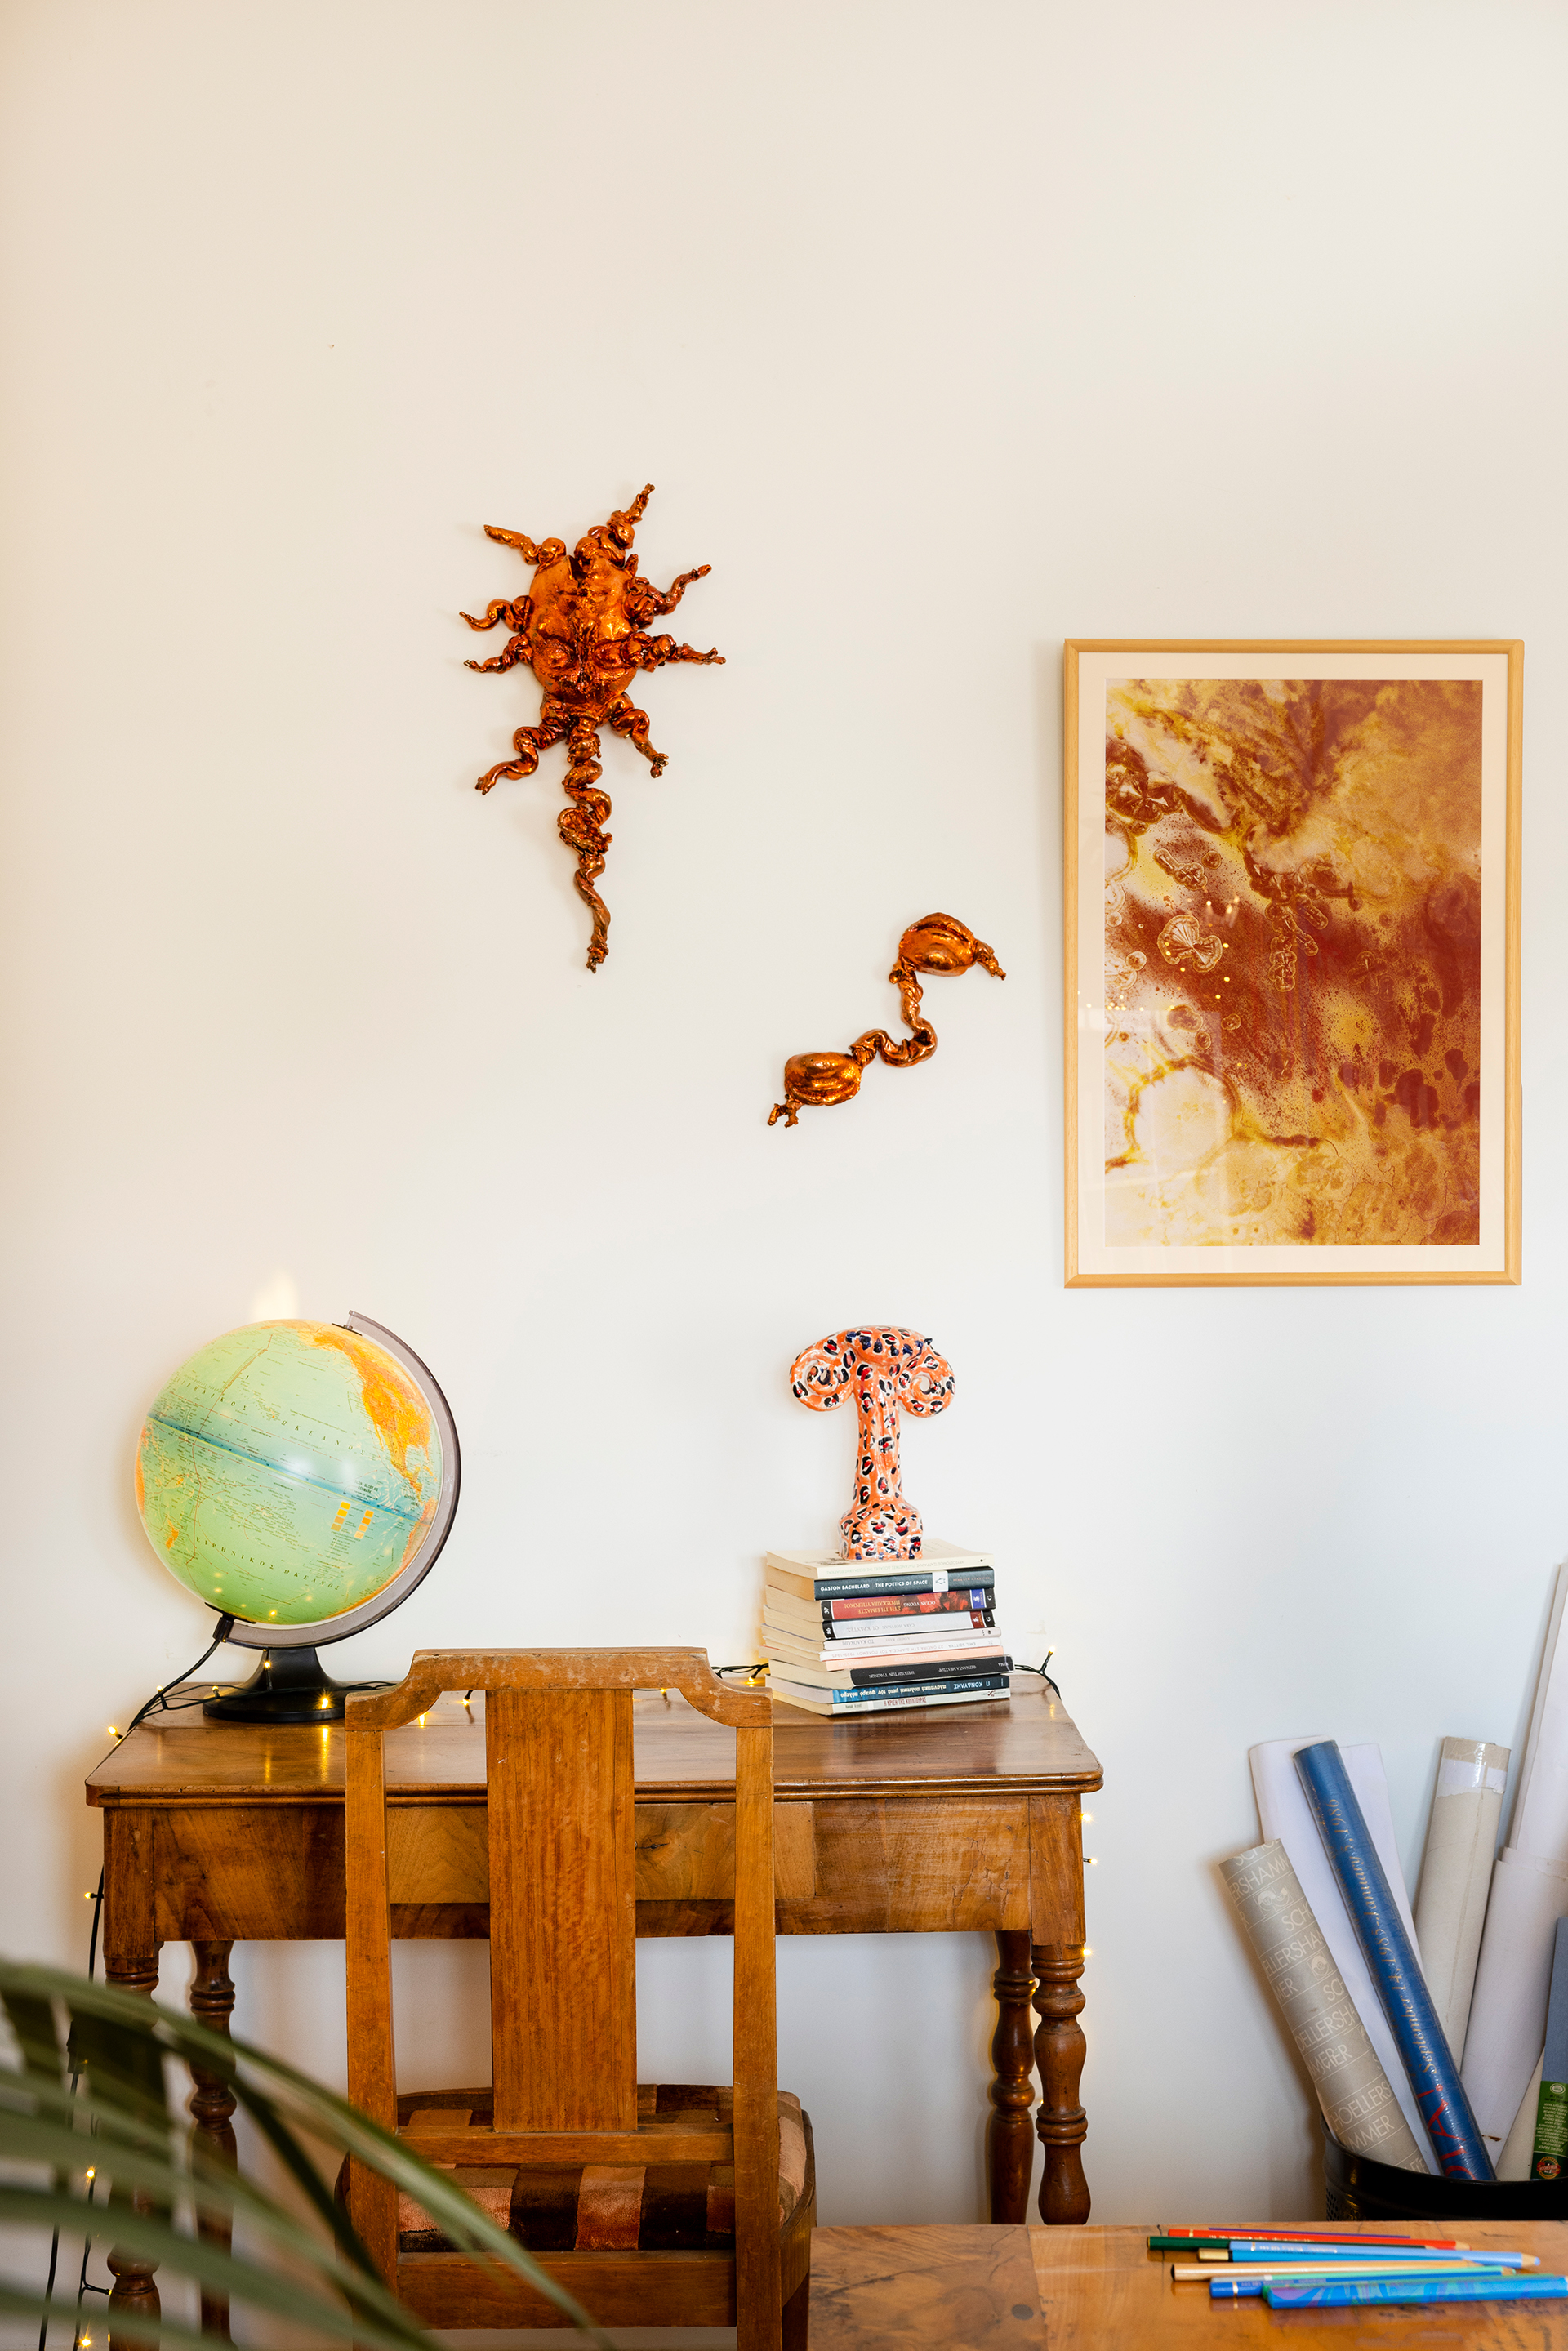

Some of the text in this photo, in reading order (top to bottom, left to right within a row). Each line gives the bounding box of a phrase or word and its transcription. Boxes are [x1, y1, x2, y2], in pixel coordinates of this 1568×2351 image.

[281, 1419, 365, 1455] ΩΚΕΑΝΟΣ
[196, 1537, 275, 1570] ΕΙΡΗΝΙΚΟΣ
[284, 1570, 341, 1591] ΩΚΕΑΝΟΣ
[906, 1696, 926, 1704] ΚΟΥΛΤΟΥΡΑΣ
[1326, 1799, 1349, 1835] 1986
[1340, 1837, 1356, 1853] 5,
[1388, 1967, 1406, 1990] 14,
[1400, 1994, 1437, 2075] September
